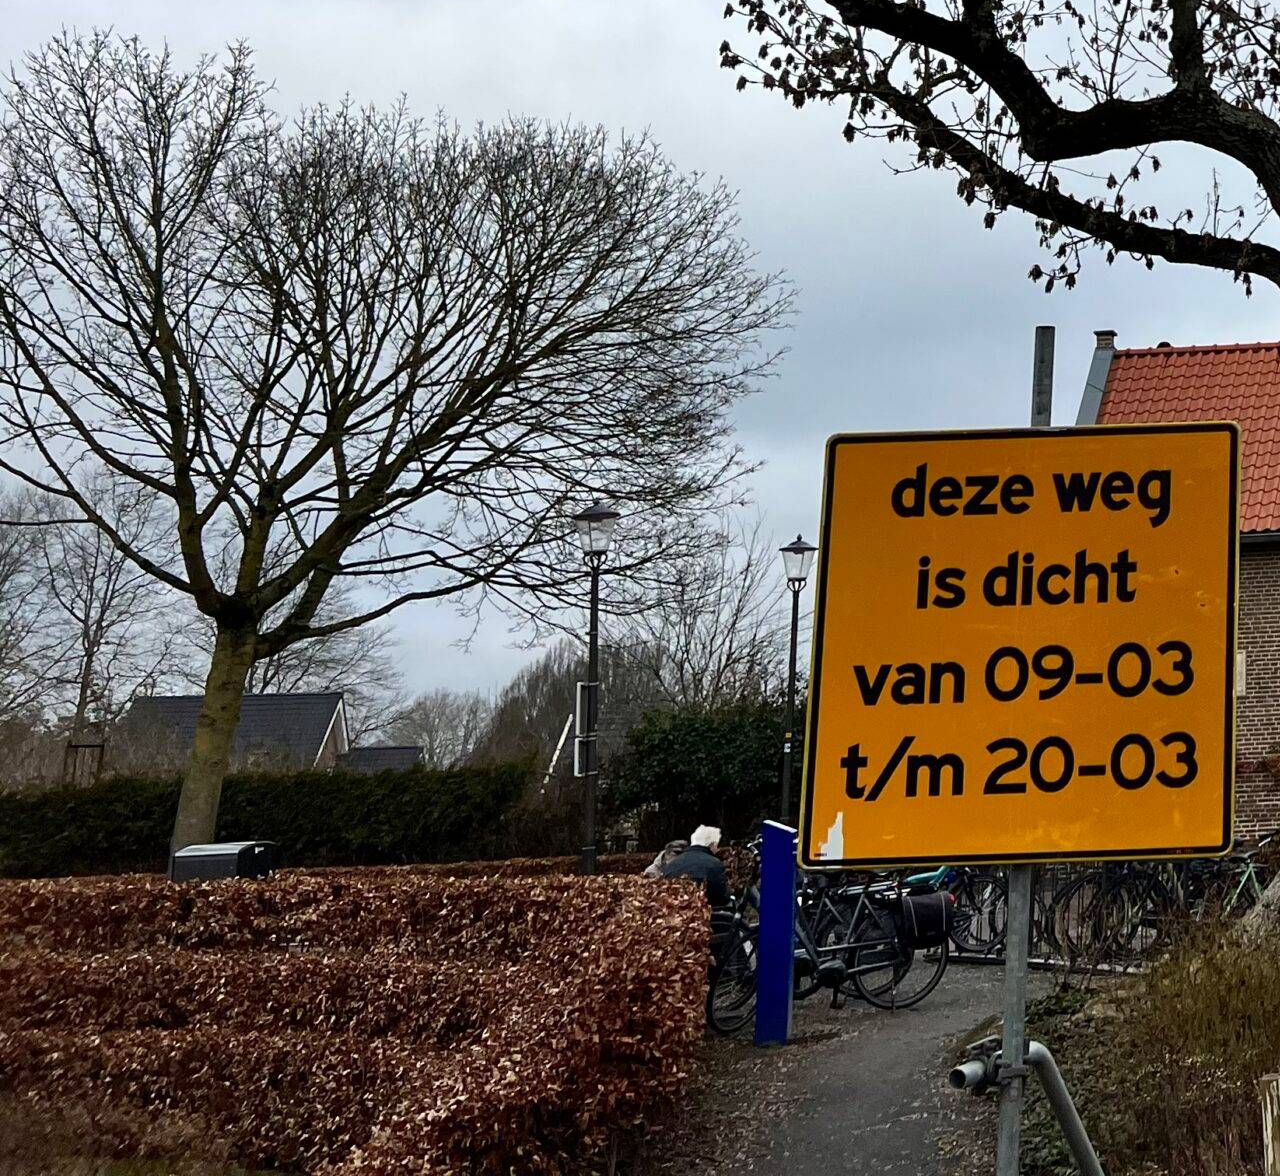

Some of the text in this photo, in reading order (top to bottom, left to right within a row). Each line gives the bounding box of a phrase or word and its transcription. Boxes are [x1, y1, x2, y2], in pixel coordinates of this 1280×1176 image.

[891, 462, 1172, 528] deze weg
[916, 548, 1137, 609] is dicht
[853, 640, 1195, 706] van 09-03
[840, 731, 1199, 802] t/m 20-03
